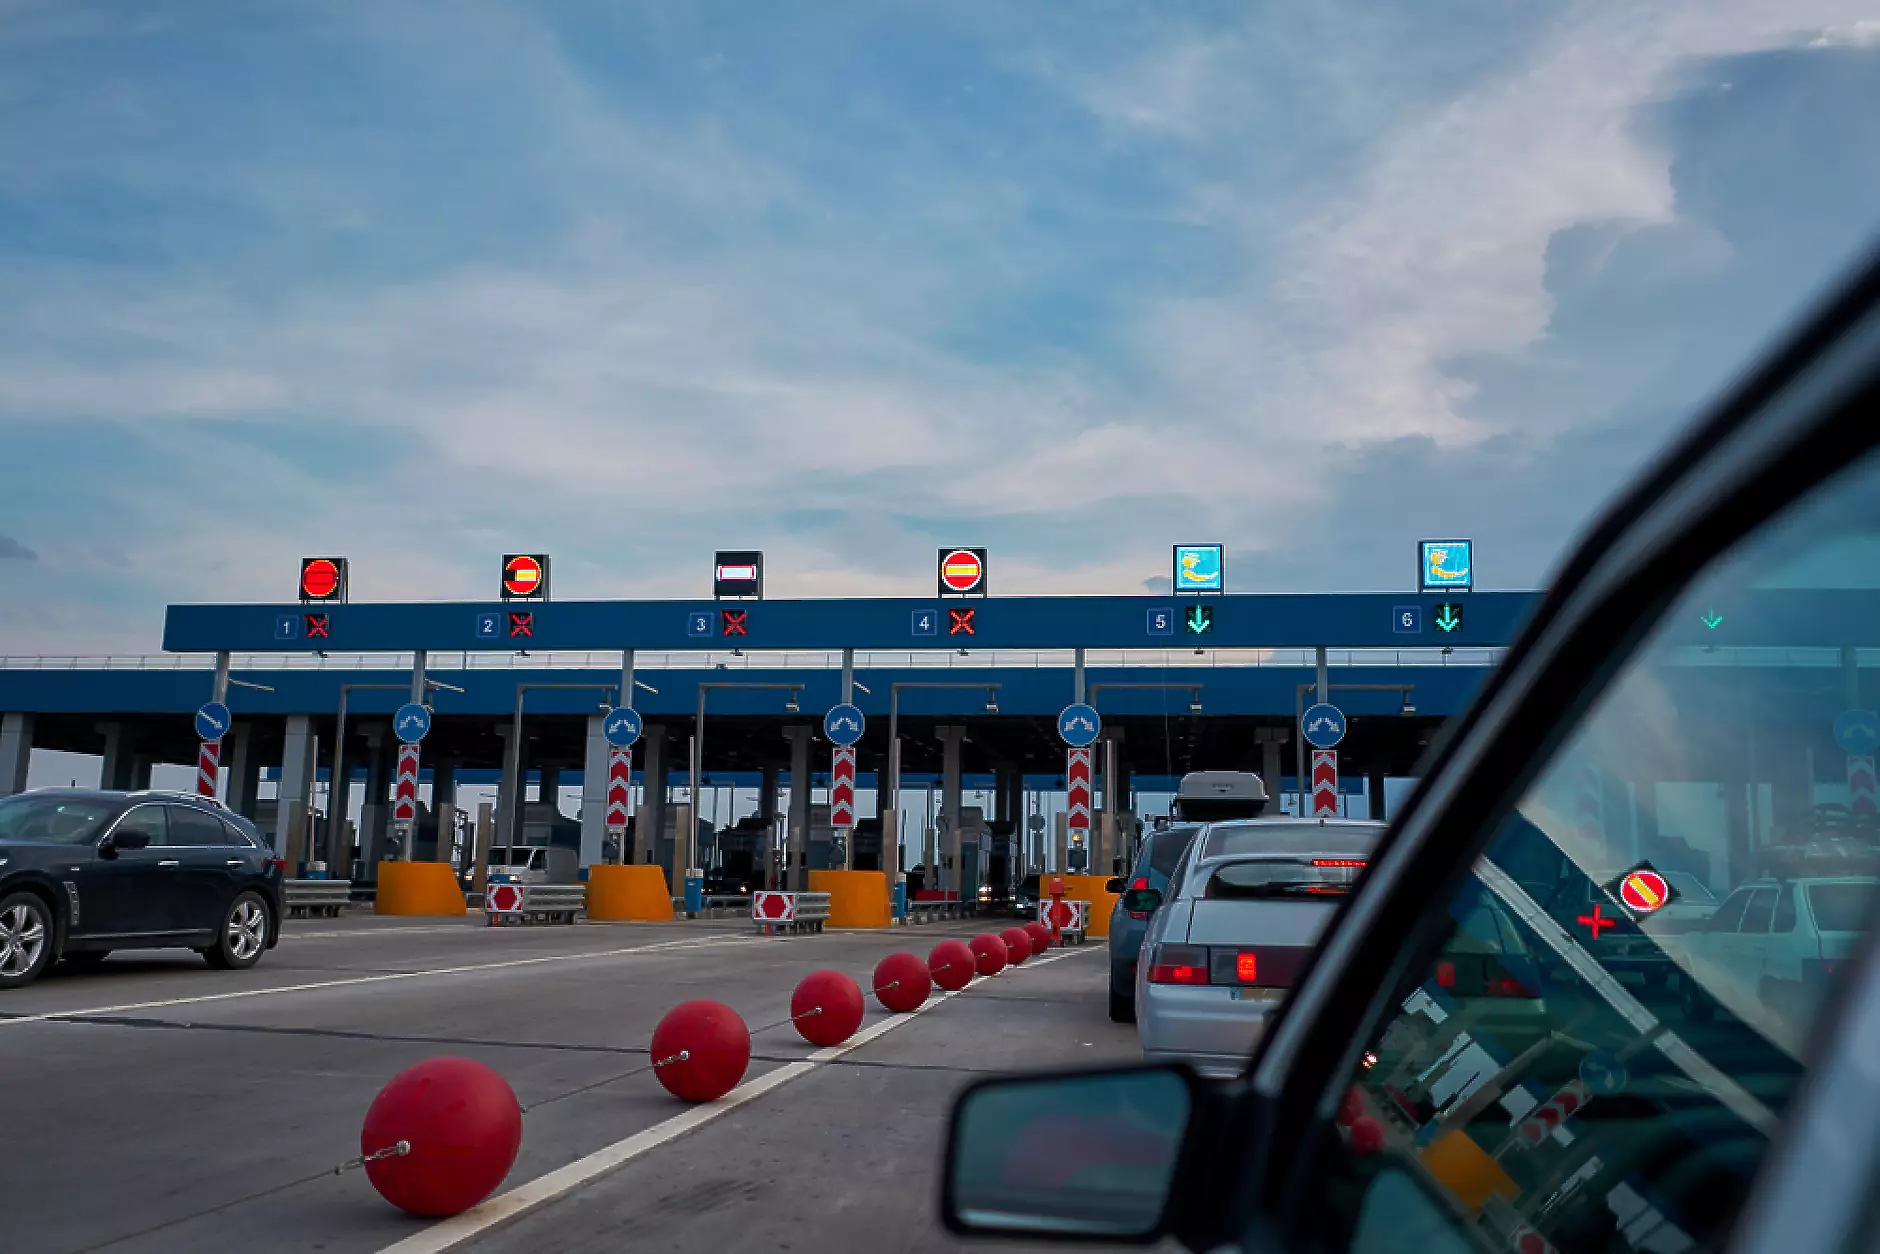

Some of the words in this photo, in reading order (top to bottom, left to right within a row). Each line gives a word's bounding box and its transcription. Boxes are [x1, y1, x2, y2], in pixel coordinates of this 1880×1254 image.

[482, 619, 493, 633] 2
[696, 618, 706, 632] 3
[918, 616, 930, 631] 4
[1155, 614, 1166, 629] 5
[1402, 612, 1413, 627] 6
[283, 621, 290, 634] 1
